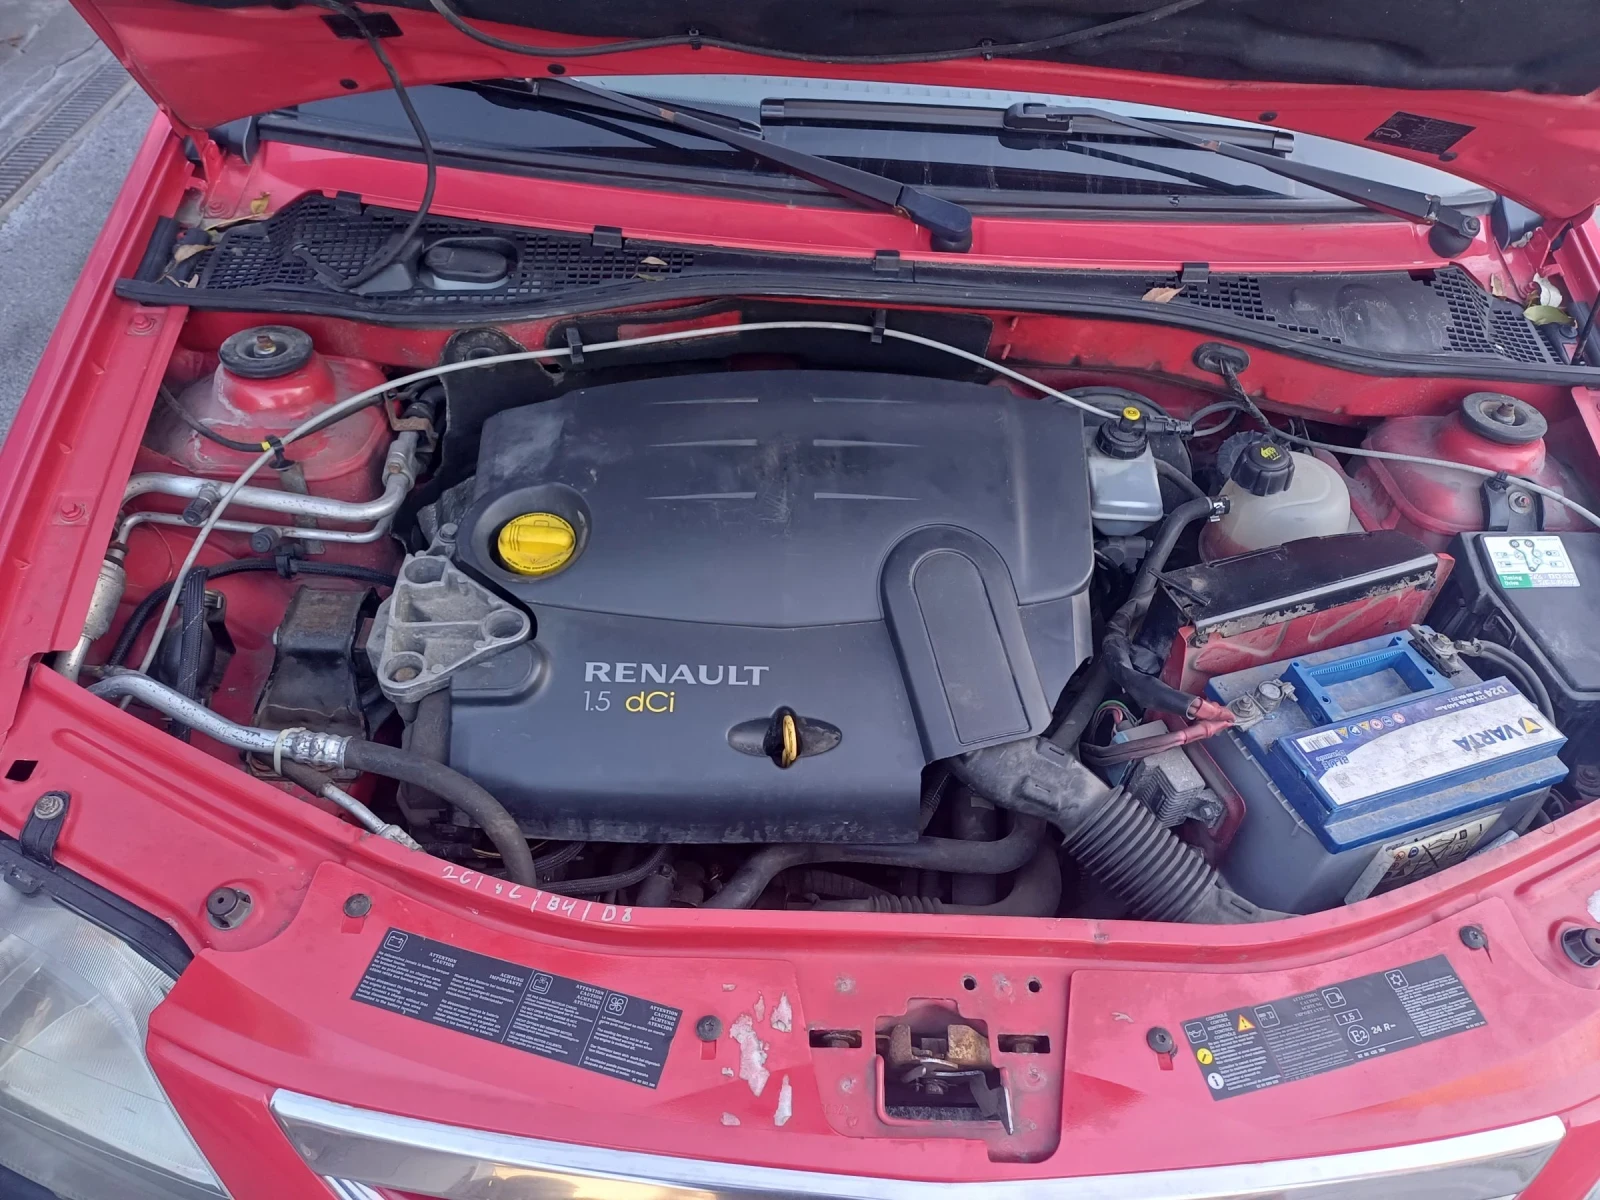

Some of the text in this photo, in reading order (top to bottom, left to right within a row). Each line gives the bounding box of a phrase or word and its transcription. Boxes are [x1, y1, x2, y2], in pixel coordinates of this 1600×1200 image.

[584, 662, 770, 687] RENAULT
[1474, 693, 1487, 701] 12V
[1484, 685, 1508, 698] D24
[583, 689, 676, 714] 1.5 dCi
[1452, 724, 1523, 751] VARTA
[1322, 755, 1348, 770] BLUE
[428, 952, 457, 963] ATTENTION
[432, 957, 454, 967] CAUTION
[489, 974, 522, 986] IMPORTANTE
[499, 972, 524, 982] ACHTUNG
[575, 984, 604, 995] ATTENTION
[579, 990, 602, 1000] CAUTION
[576, 994, 600, 1004] ACHTUNG
[649, 1005, 677, 1016] ATTENTION
[653, 1011, 676, 1021] CAUTION
[649, 1015, 674, 1026] ACHTUNG
[1341, 1012, 1357, 1023] 1,5
[1370, 1025, 1382, 1034] 24
